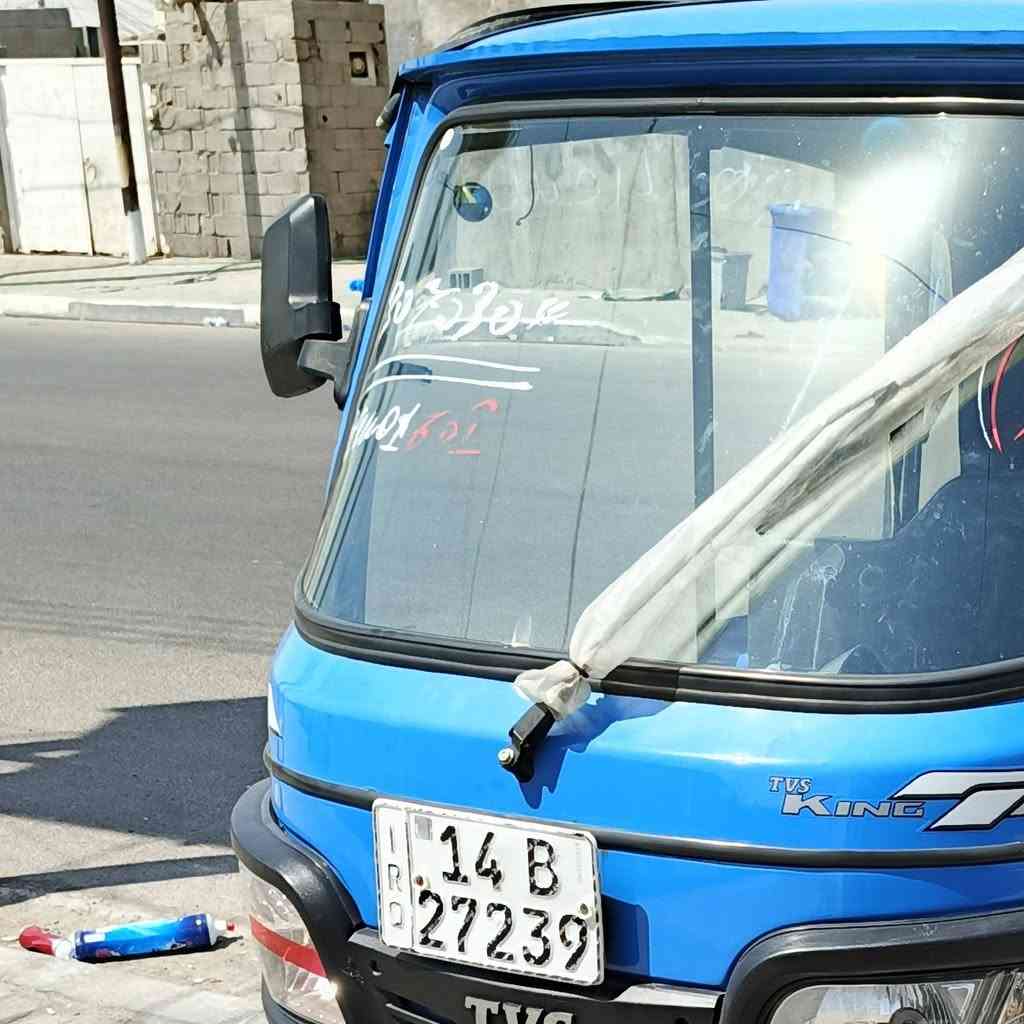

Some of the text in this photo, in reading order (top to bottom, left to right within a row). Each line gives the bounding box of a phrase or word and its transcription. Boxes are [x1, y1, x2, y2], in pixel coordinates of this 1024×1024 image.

[769, 775, 812, 794] TVS
[440, 825, 561, 897] 14 B
[418, 889, 589, 971] 27239
